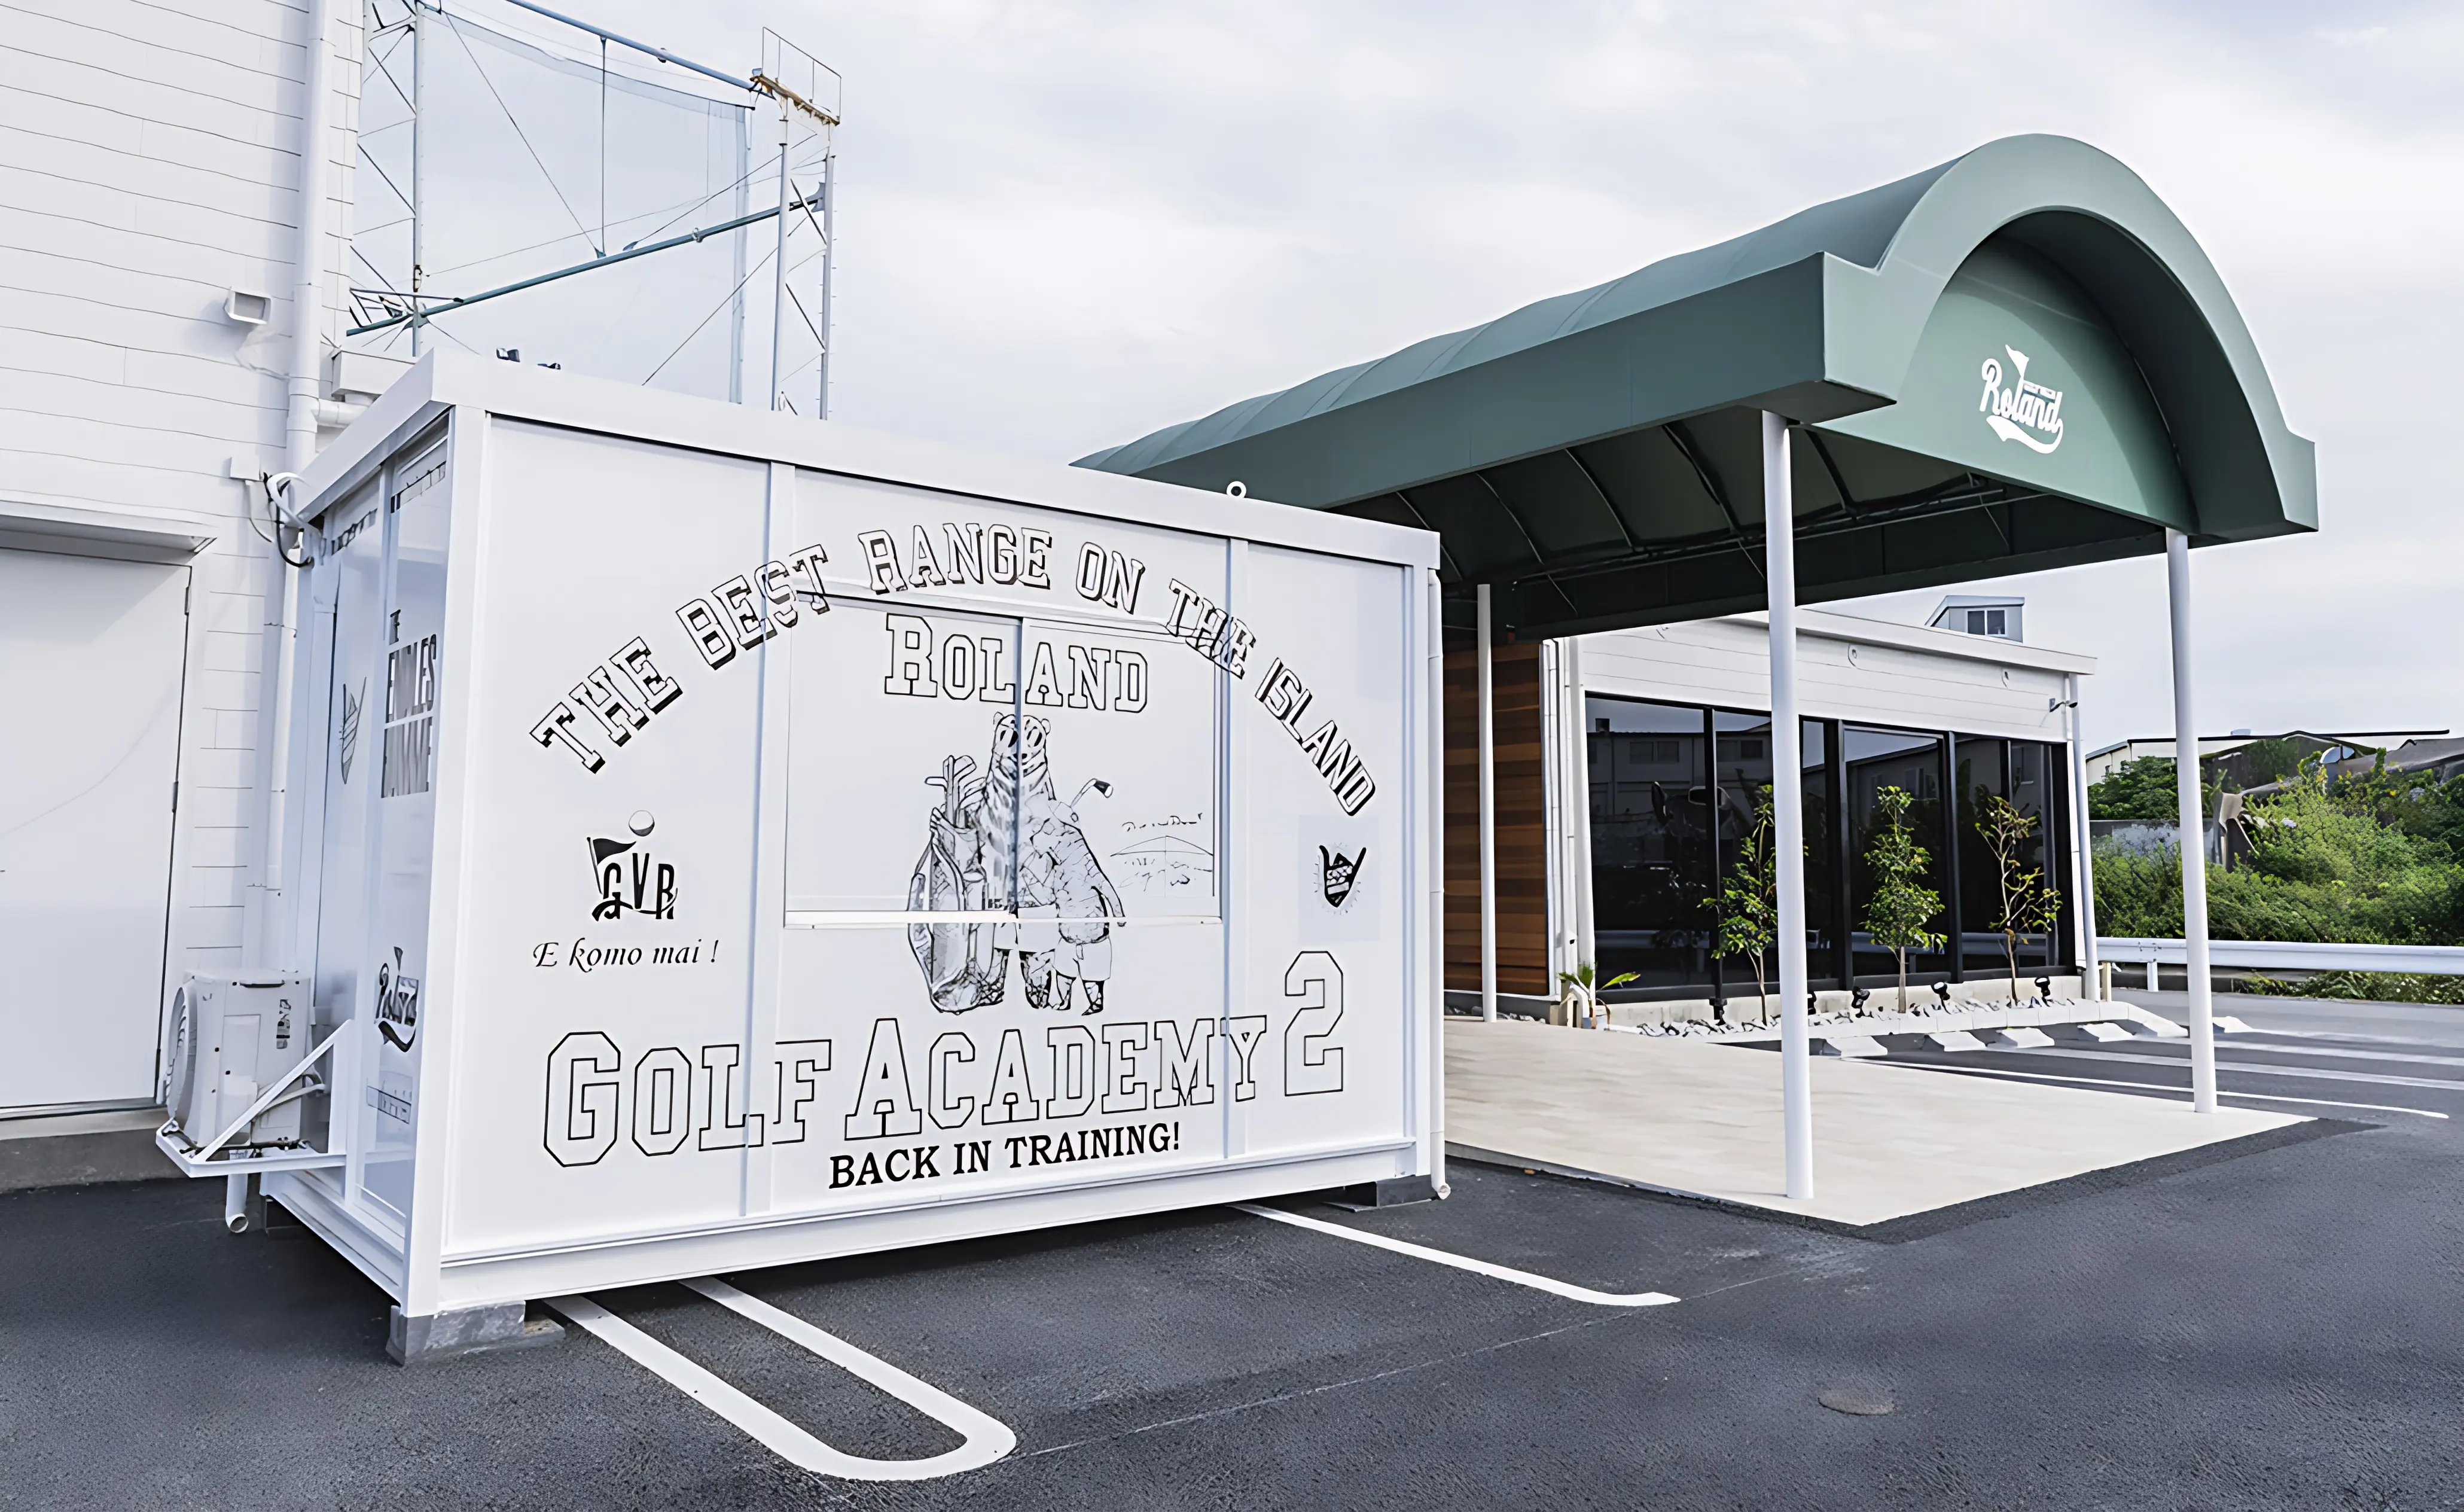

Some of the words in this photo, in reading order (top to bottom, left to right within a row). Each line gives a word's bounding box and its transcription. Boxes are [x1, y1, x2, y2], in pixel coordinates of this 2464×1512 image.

[1980, 358, 2063, 434] Roland
[529, 636, 683, 774] THE
[675, 544, 830, 670] BEST
[858, 522, 1053, 595] RANGE
[1076, 541, 1145, 615] ON
[1165, 578, 1257, 680] THE
[1255, 657, 1376, 817] ISLAND
[884, 612, 1148, 714] ROLAND
[602, 852, 675, 920] GVR
[533, 941, 559, 968] E
[569, 937, 642, 973] komo
[543, 1031, 832, 1167] GOLF
[844, 1014, 1268, 1141] ACADEMY
[1284, 950, 1344, 1096] 2
[829, 1145, 941, 1190] BACK
[953, 1140, 993, 1176] IN
[1005, 1121, 1181, 1170] TRAINING!
